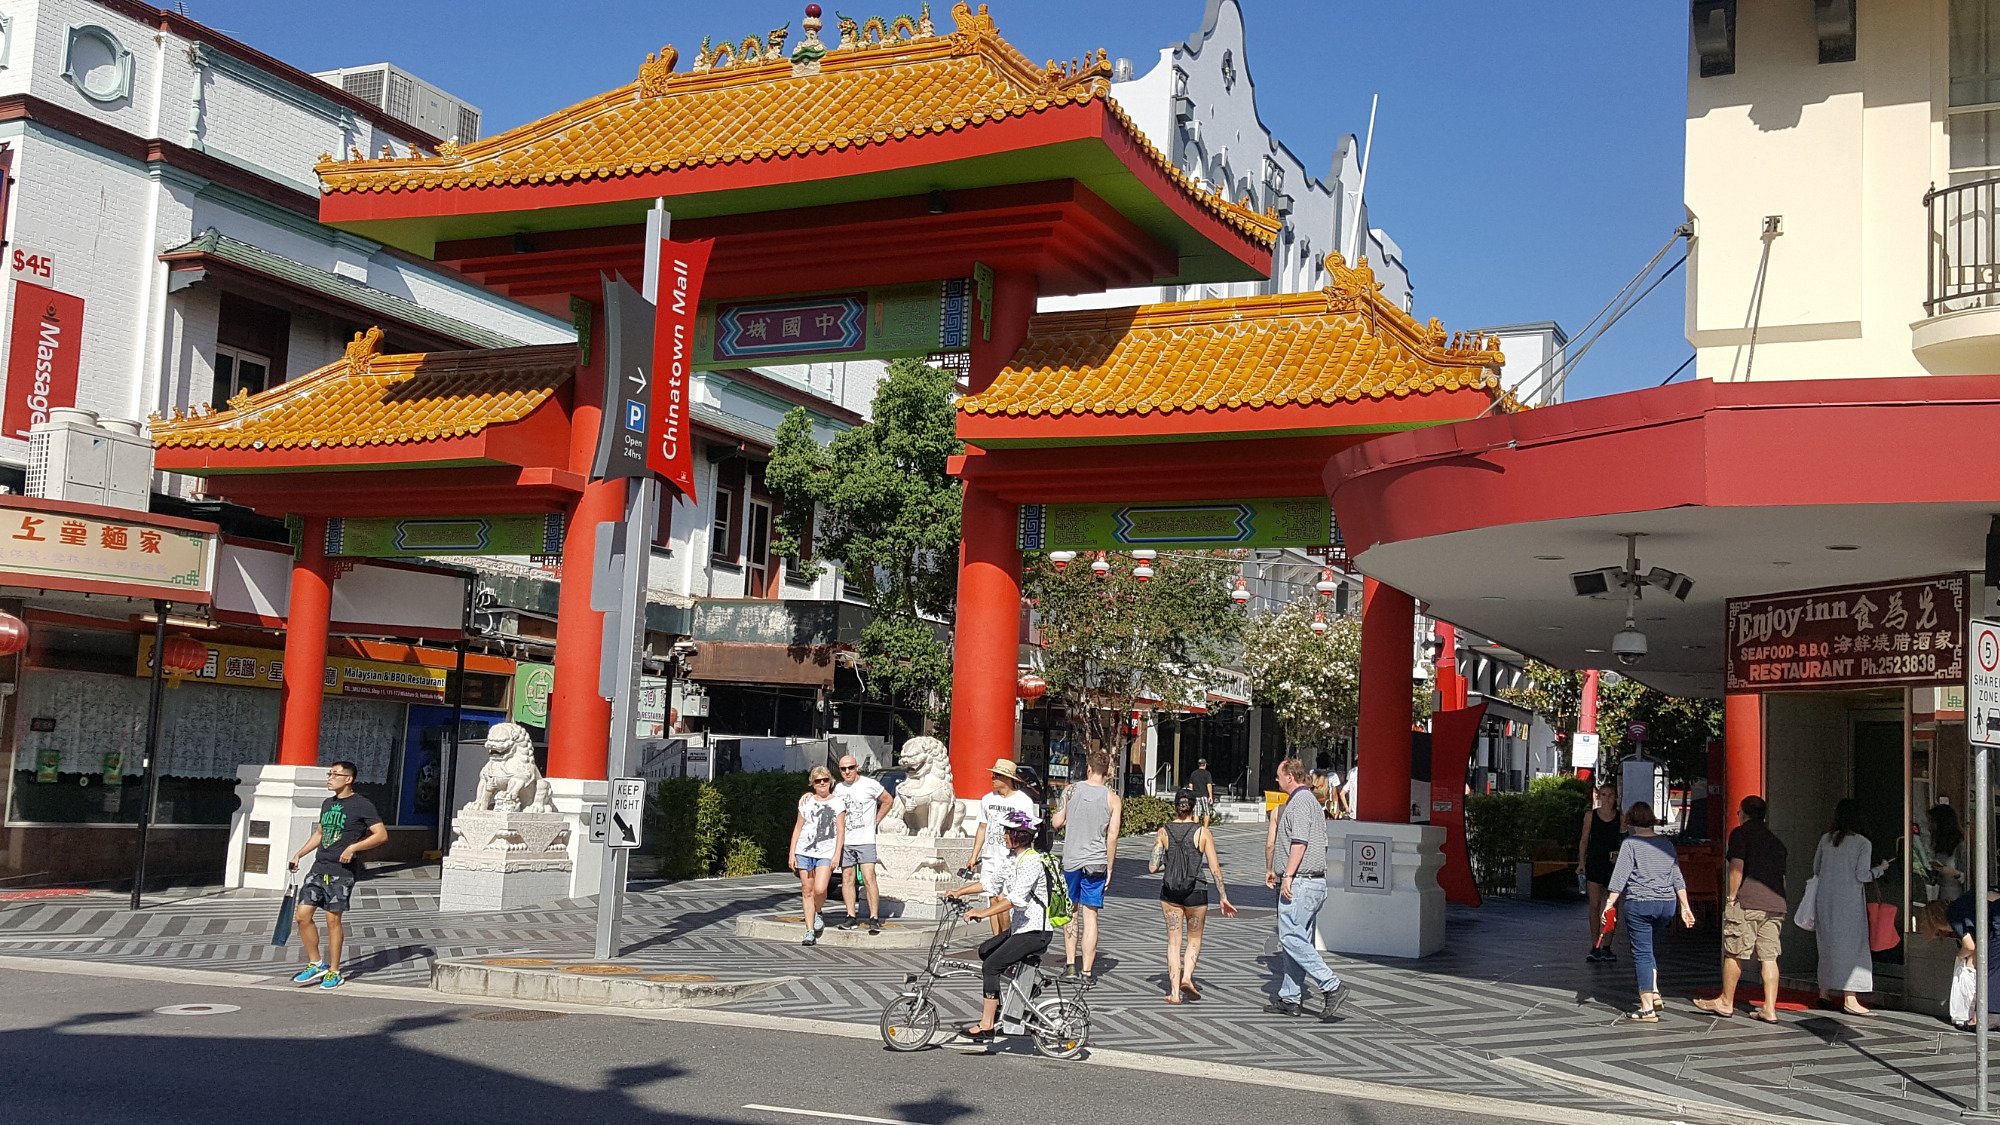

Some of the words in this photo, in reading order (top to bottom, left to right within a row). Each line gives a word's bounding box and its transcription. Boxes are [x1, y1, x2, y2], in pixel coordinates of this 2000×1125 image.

[12, 249, 51, 278] $45
[672, 259, 688, 316] Mall
[27, 321, 60, 424] Massage
[663, 324, 685, 460] Chinatown
[630, 405, 641, 426] P
[625, 435, 643, 447] Open
[624, 447, 642, 460] 24hrs
[1736, 605, 1804, 647] Enjoy
[1805, 599, 1848, 621] inn
[1985, 642, 1992, 659] 5
[344, 667, 382, 682] Malaysian
[384, 672, 389, 681] &
[391, 672, 406, 682] BBQ
[408, 674, 445, 687] Restaurant
[1749, 658, 1855, 681] RESTAURANT
[1974, 674, 2000, 688] SHARE
[1979, 690, 1998, 702] ZONE
[618, 785, 640, 796] KEEP
[614, 799, 640, 810] RIGHT
[596, 812, 606, 825] EX
